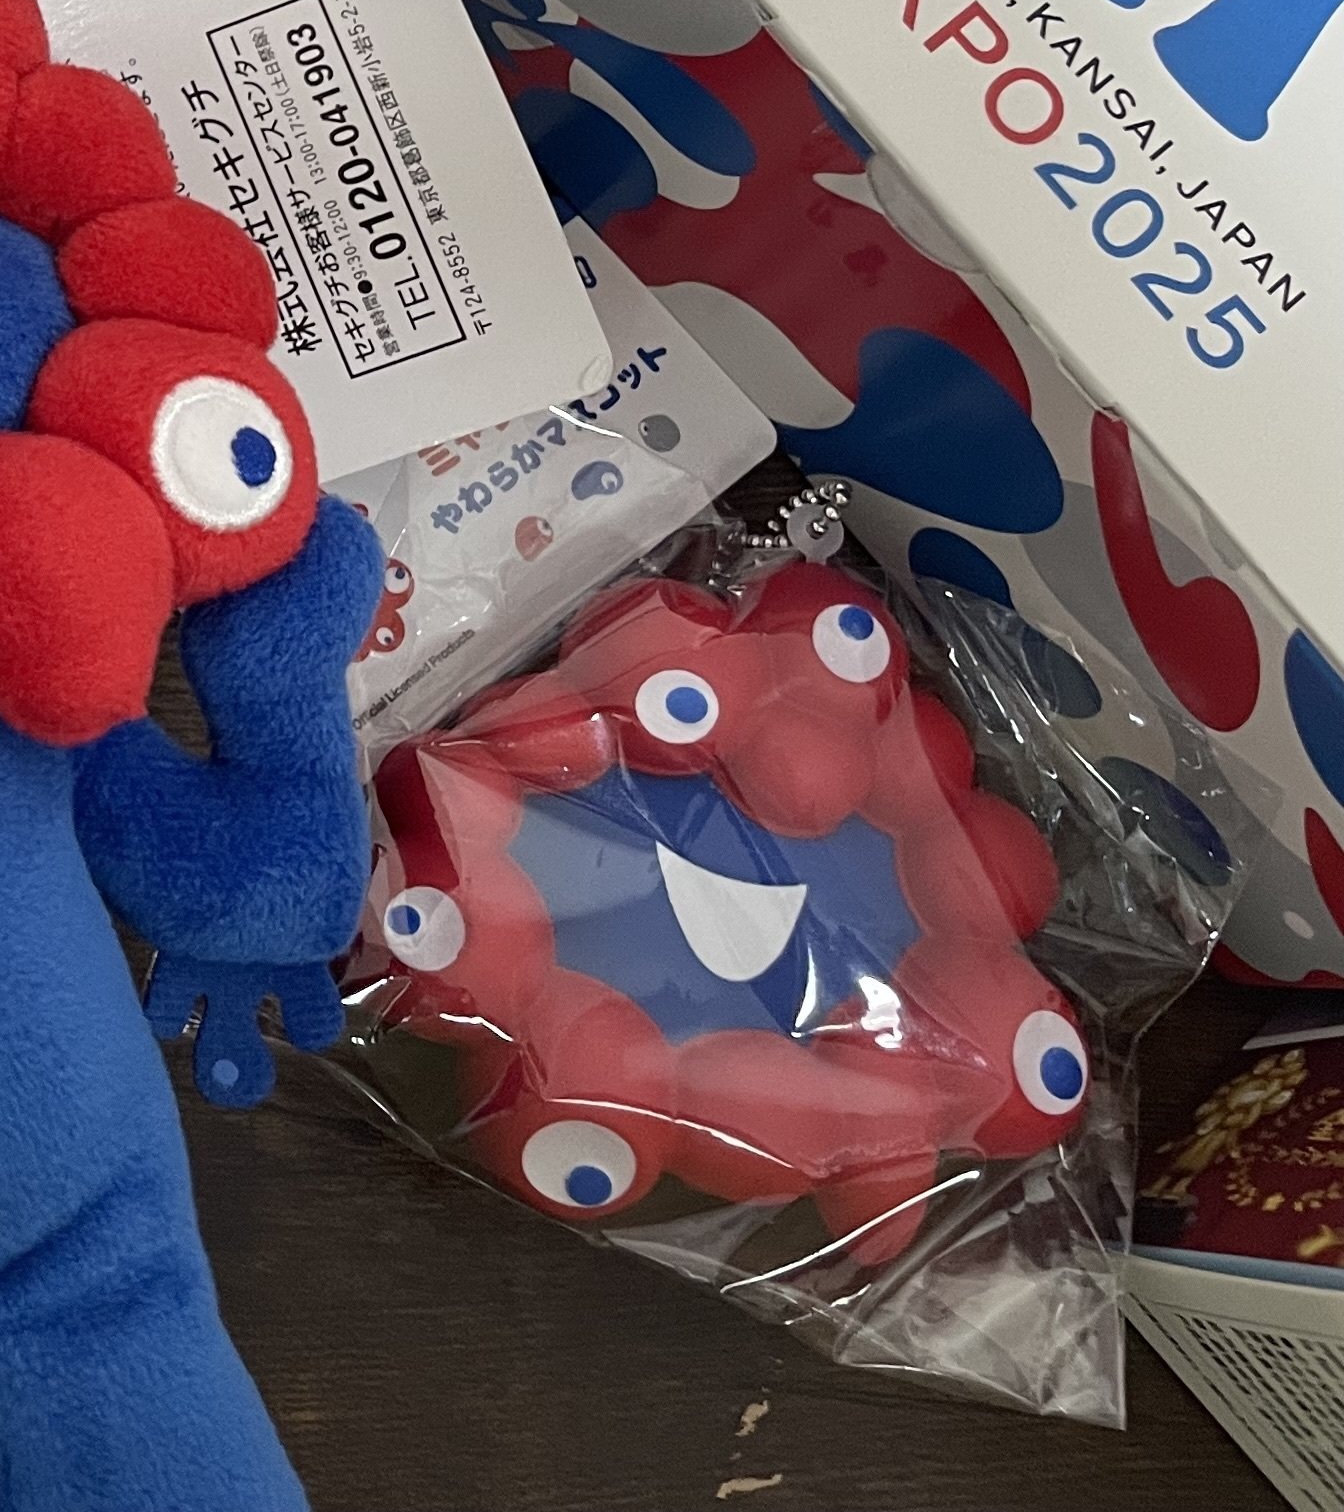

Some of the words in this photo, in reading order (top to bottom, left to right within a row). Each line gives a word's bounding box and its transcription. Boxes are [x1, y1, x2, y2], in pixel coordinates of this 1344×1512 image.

[228, 34, 377, 363] セキグチお客様サービスセンター
[1025, 1, 1176, 177] KANSAI,
[1176, 179, 1308, 314] JAPAN
[384, 659, 434, 712] Licensed
[427, 628, 476, 675] Products
